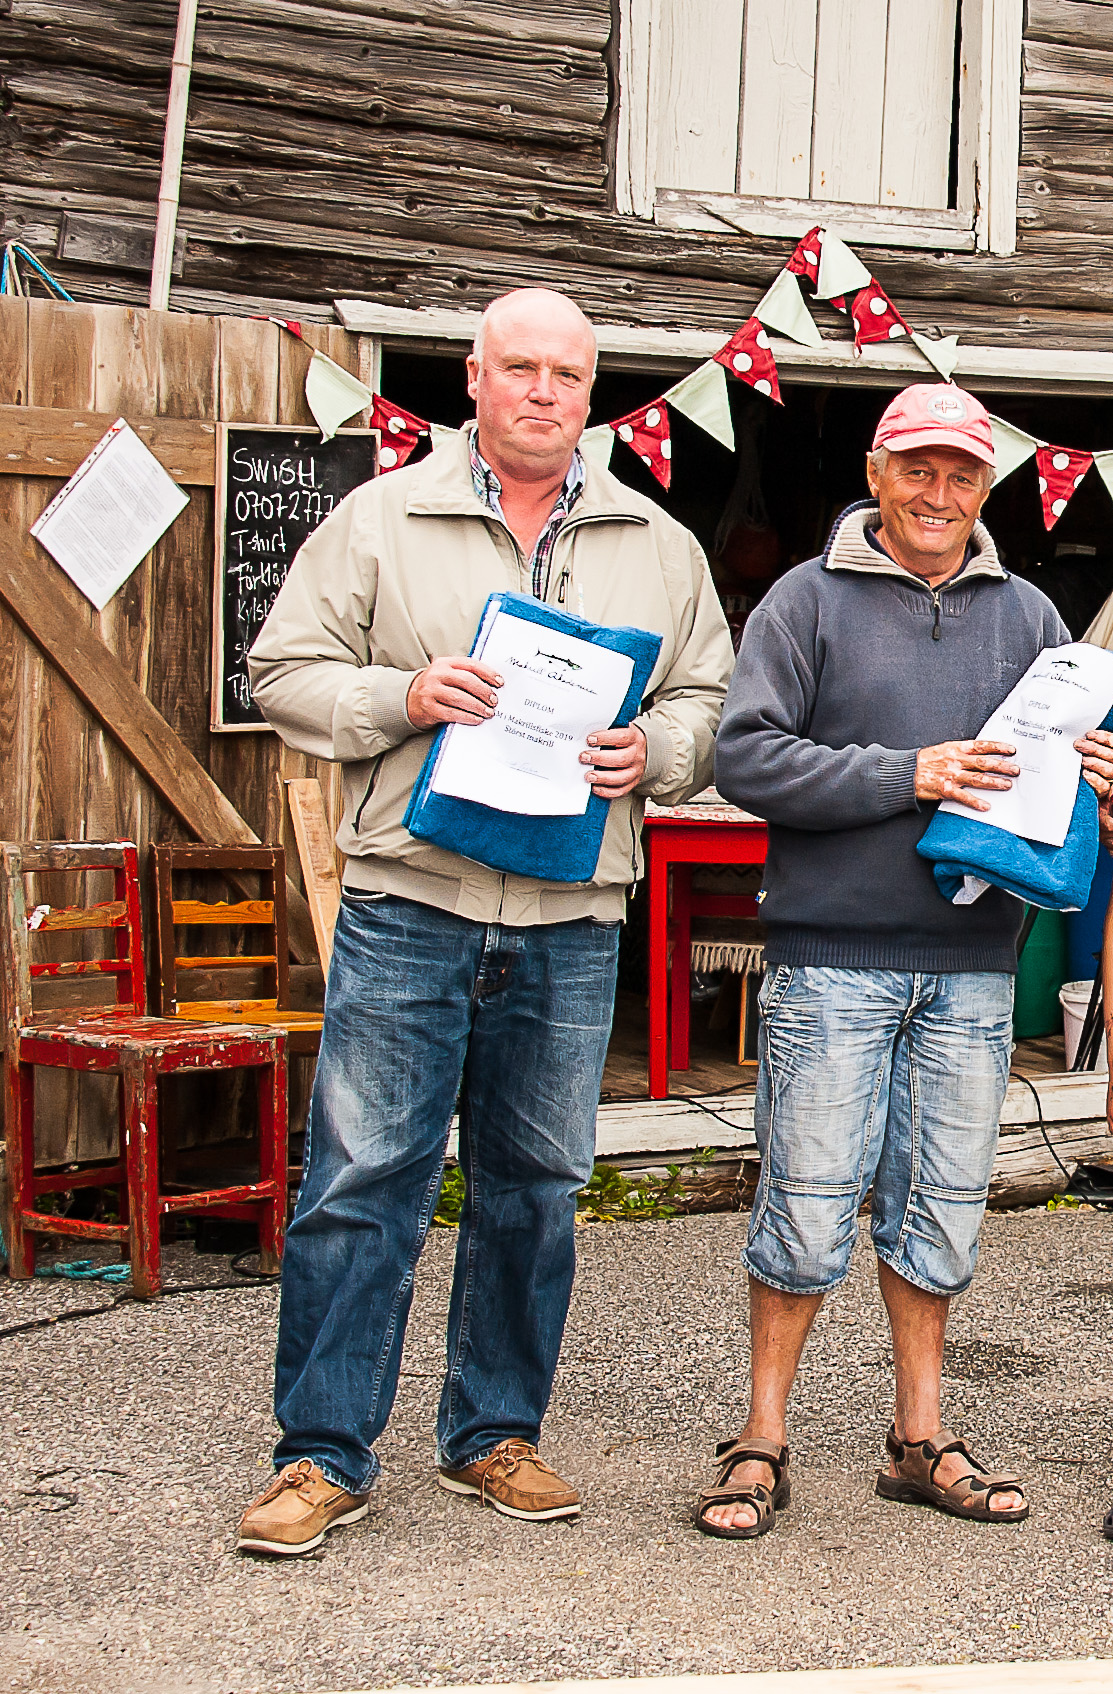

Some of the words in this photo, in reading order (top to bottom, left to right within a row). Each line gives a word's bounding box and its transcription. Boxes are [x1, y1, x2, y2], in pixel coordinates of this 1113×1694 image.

[235, 490, 337, 524] 07072777
[231, 526, 287, 557] T-shirt
[228, 561, 289, 595] Förkläd
[237, 592, 277, 626] Kylsk
[524, 698, 555, 714] DIPLOM
[526, 735, 555, 748] makrill
[555, 730, 574, 741] 2019
